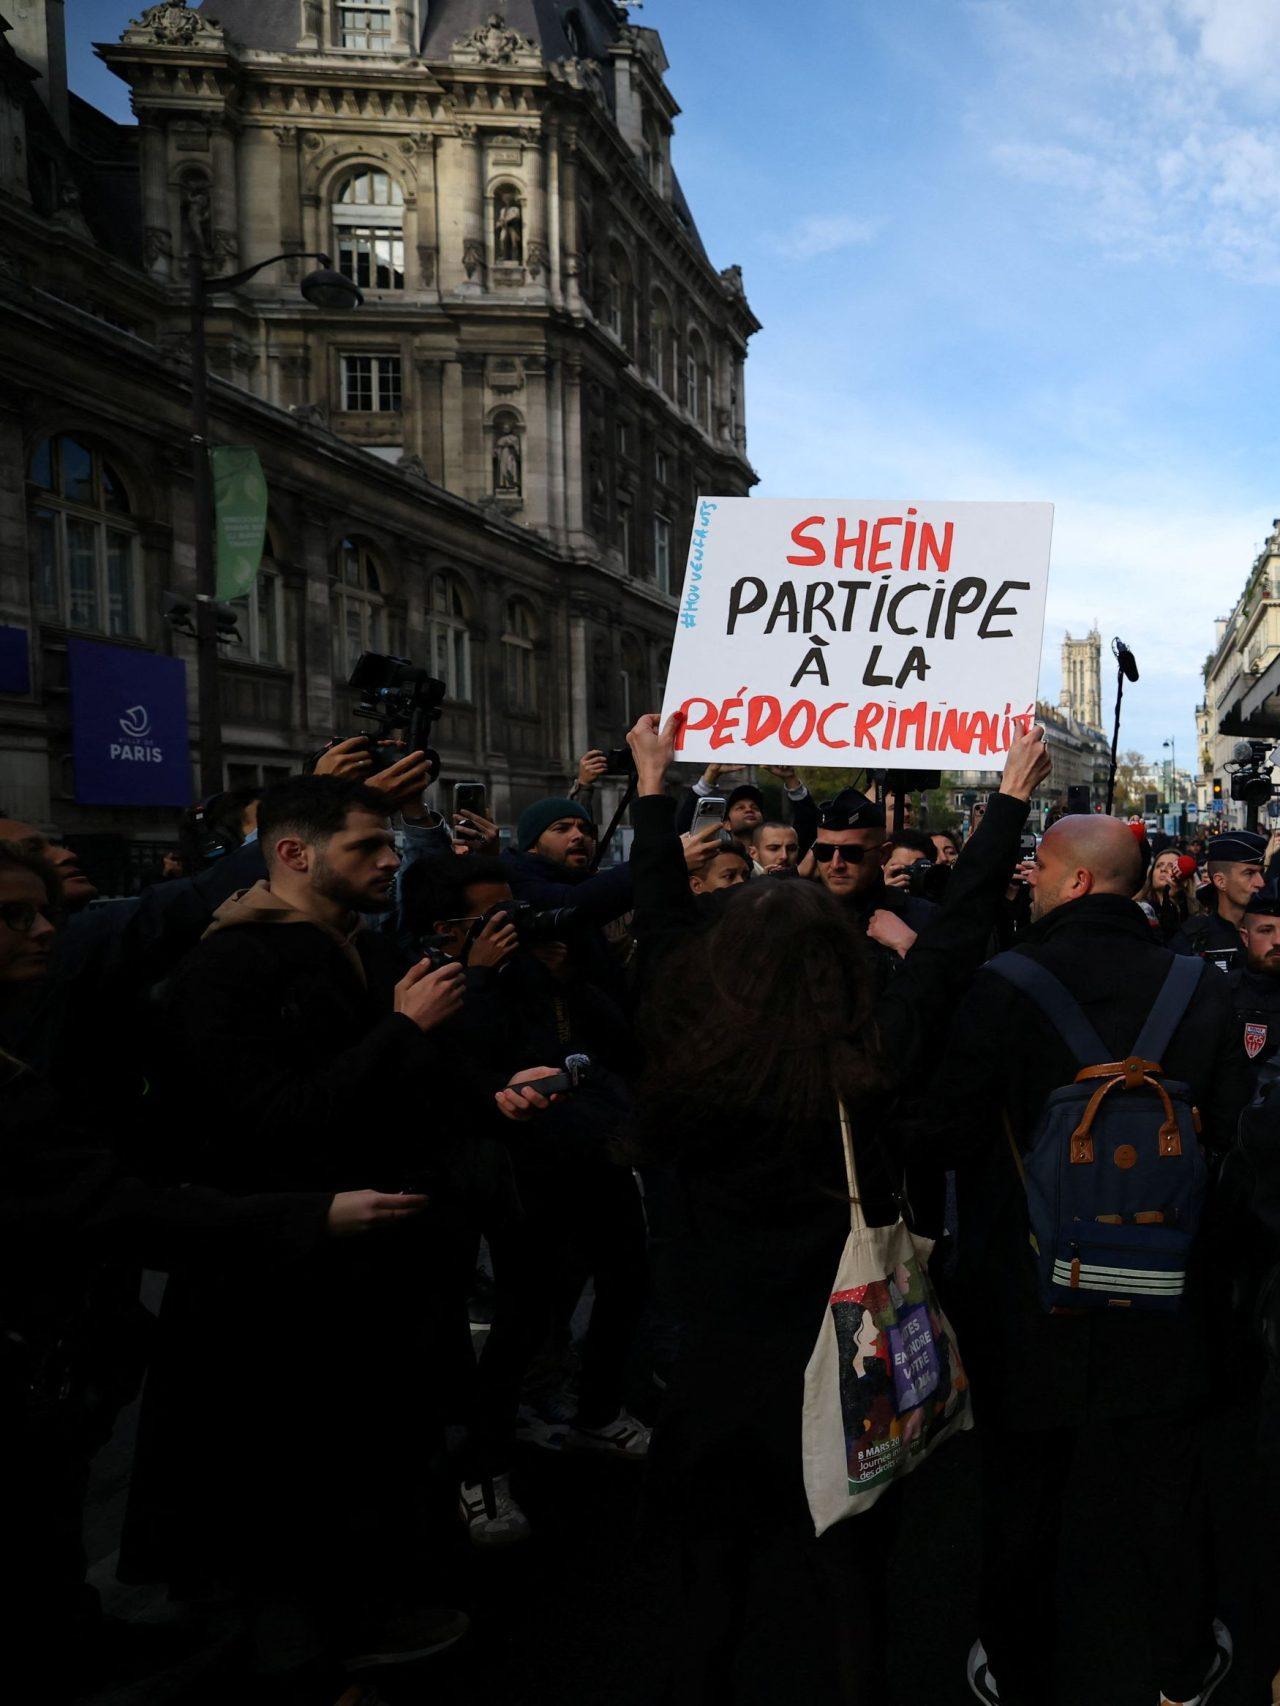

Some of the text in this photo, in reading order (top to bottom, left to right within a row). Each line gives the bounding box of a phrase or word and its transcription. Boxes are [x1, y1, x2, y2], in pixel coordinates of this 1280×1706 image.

[789, 634, 932, 689] À LA
[110, 743, 163, 763] PARIS
[857, 1450, 865, 1460] 8
[865, 1442, 890, 1458] MARS
[860, 1469, 876, 1480] des
